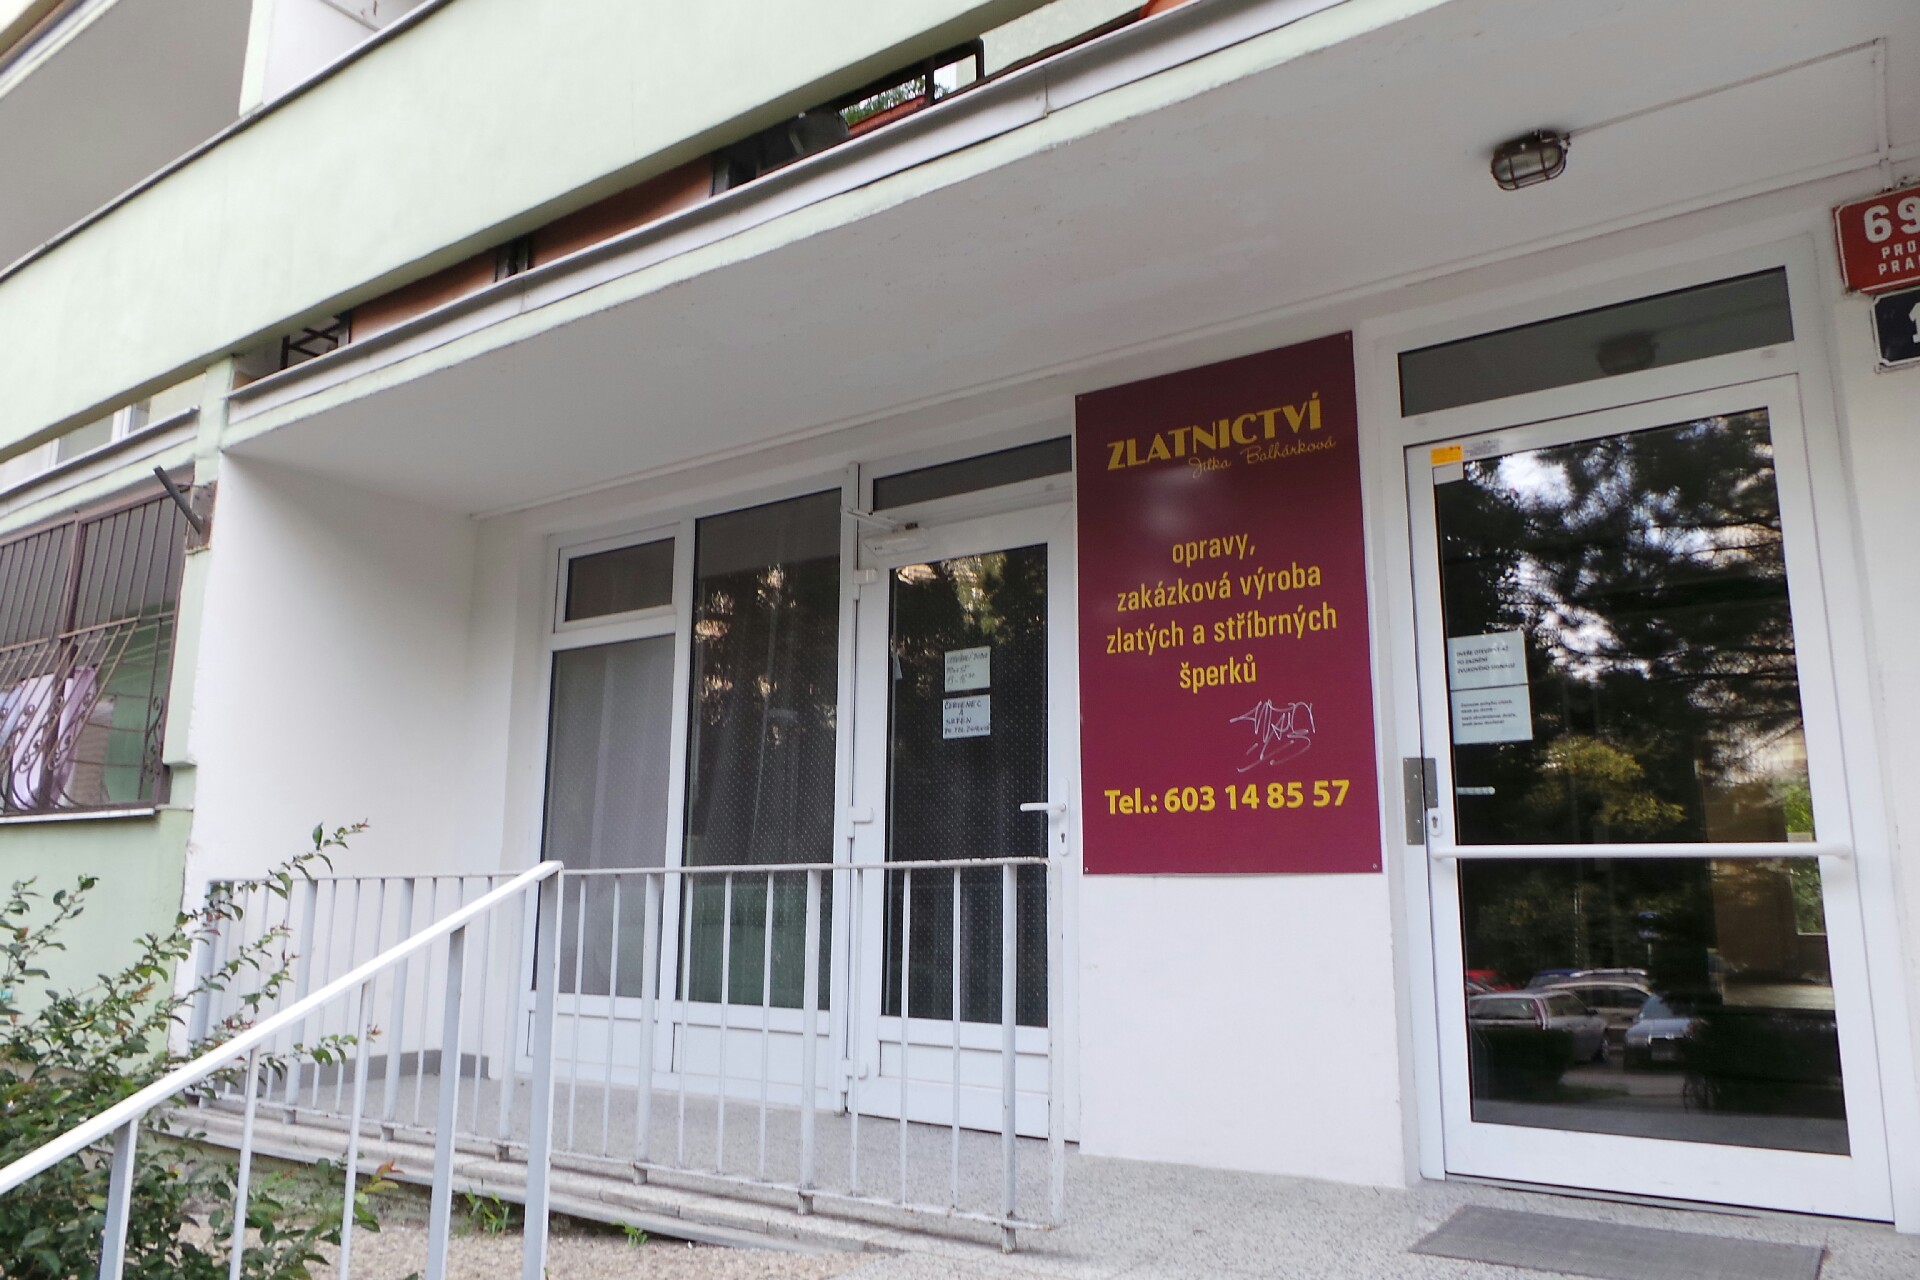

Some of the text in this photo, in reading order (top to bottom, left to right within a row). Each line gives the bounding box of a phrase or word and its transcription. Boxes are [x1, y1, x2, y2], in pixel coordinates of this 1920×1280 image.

[1878, 254, 1920, 276] PRA
[1106, 391, 1322, 470] ZLATNICTVÍ
[1188, 456, 1232, 479] Jitka
[1172, 533, 1256, 568] opravy,
[1117, 561, 1321, 612] zakázková výroba
[1106, 601, 1337, 656] zlatých a stříbrných
[1179, 654, 1257, 694] šperků
[1104, 779, 1350, 815] Tel.: 603 14 85 57
